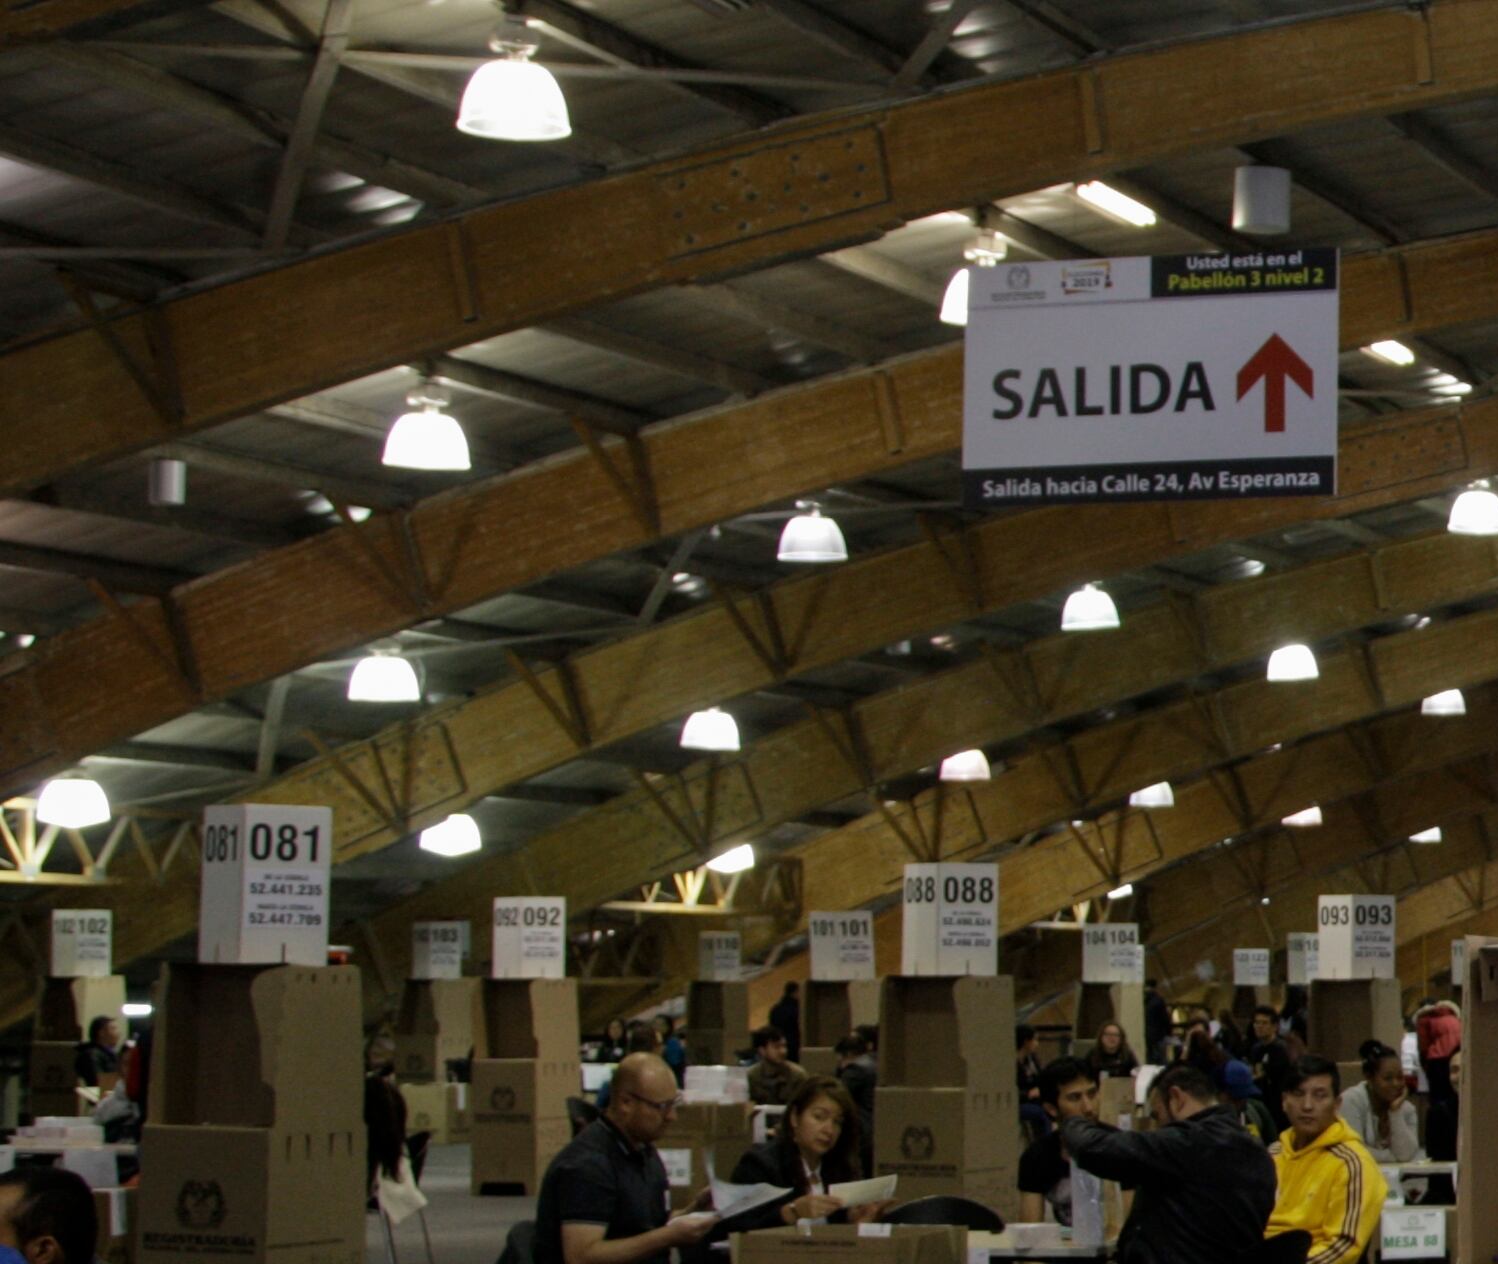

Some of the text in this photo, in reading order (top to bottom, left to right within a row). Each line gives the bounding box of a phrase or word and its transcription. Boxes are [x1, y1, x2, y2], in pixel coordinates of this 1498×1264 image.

[1186, 250, 1303, 270] Usted está en el
[1168, 268, 1325, 291] Pabellón 3 nivel 2
[991, 361, 1216, 420] SALIDA
[983, 471, 1320, 499] Salida hacia Calle 24, Av Esperanza
[205, 823, 239, 863] 081
[249, 822, 321, 863] 081
[944, 875, 995, 904] 088
[523, 906, 561, 927] 092
[1320, 905, 1350, 926] 093
[1355, 904, 1393, 926] 093
[812, 919, 835, 937] 101
[838, 919, 869, 937] 101
[1085, 930, 1107, 945] 104
[1110, 929, 1136, 945] 104
